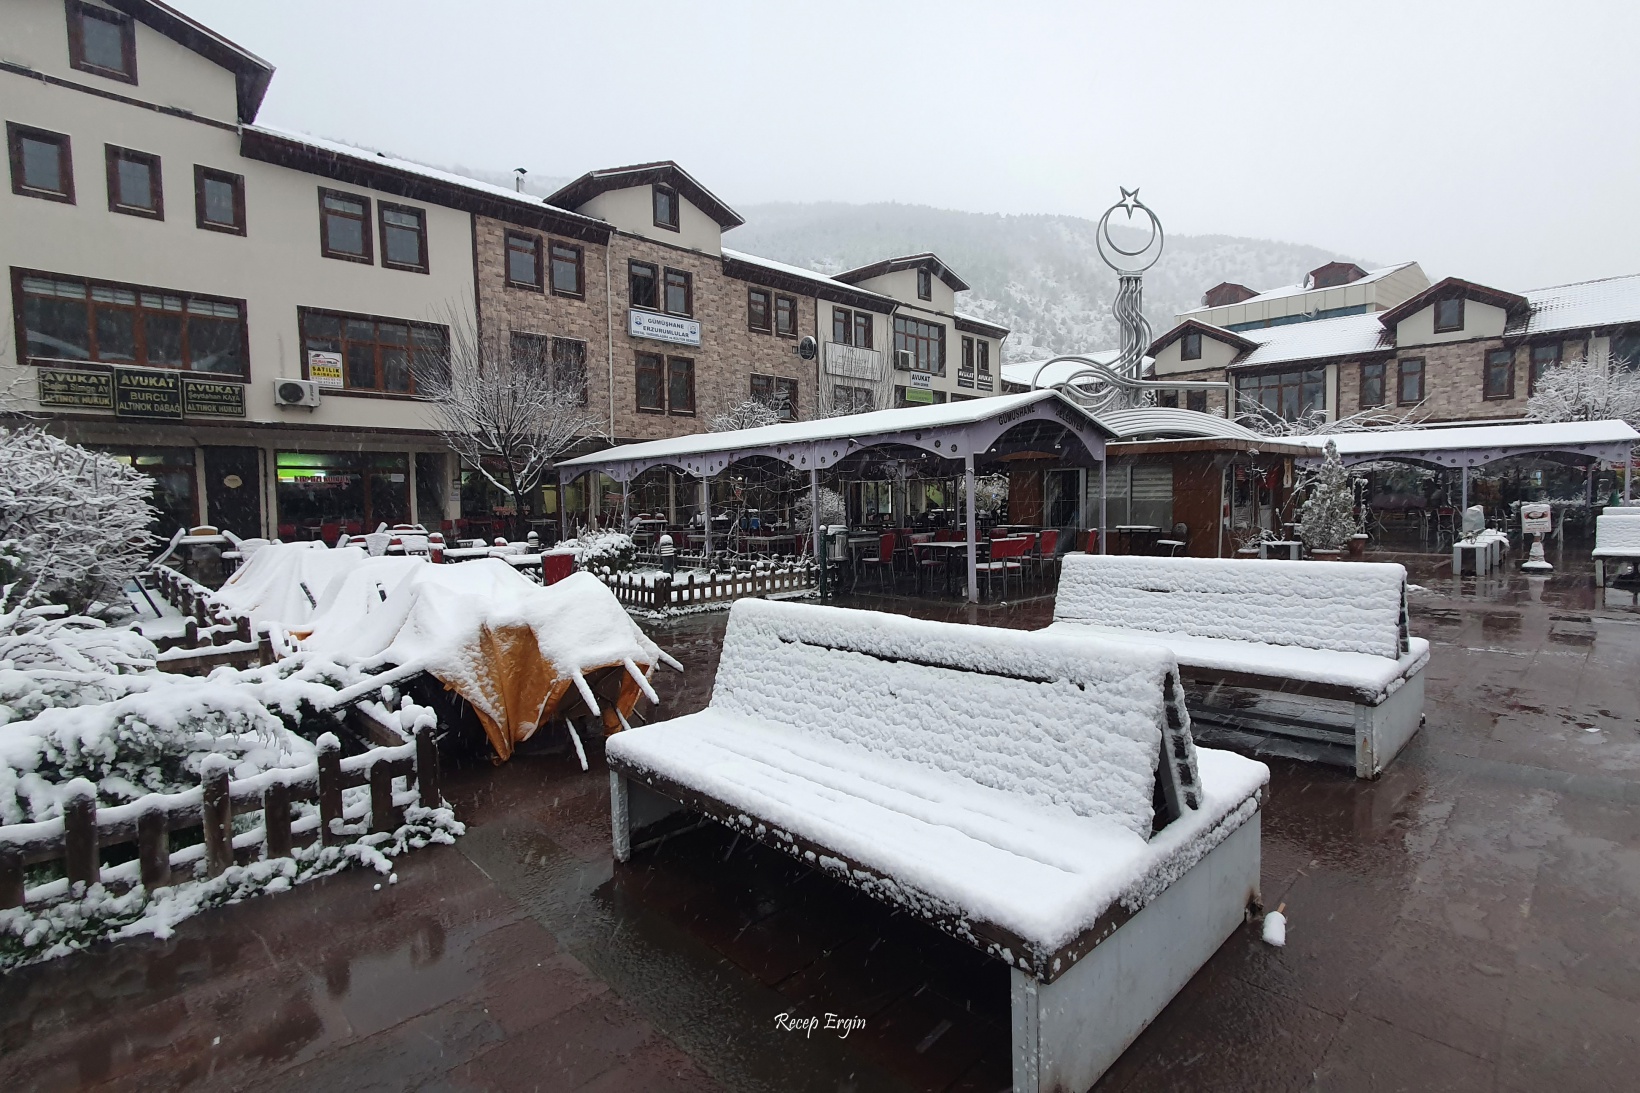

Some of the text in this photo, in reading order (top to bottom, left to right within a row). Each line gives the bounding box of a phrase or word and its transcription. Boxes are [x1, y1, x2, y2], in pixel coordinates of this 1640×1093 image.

[648, 318, 684, 329] GÜMÜŞHANE
[643, 325, 689, 337] ERZURUMLULAR
[312, 366, 340, 374] SATILIK
[44, 372, 109, 385] AVUKAT
[121, 374, 175, 388] AVUKAT
[911, 373, 931, 383] AVUKAT
[98, 385, 109, 393] AY
[187, 383, 241, 395] AVUKAT
[44, 394, 110, 406] ALTINOK HUKUK
[130, 391, 168, 402] BURCU
[222, 394, 241, 402] KAYA
[119, 401, 181, 413] ALTINOK DABAĞ
[187, 403, 243, 414] ALTINOK HUKUK
